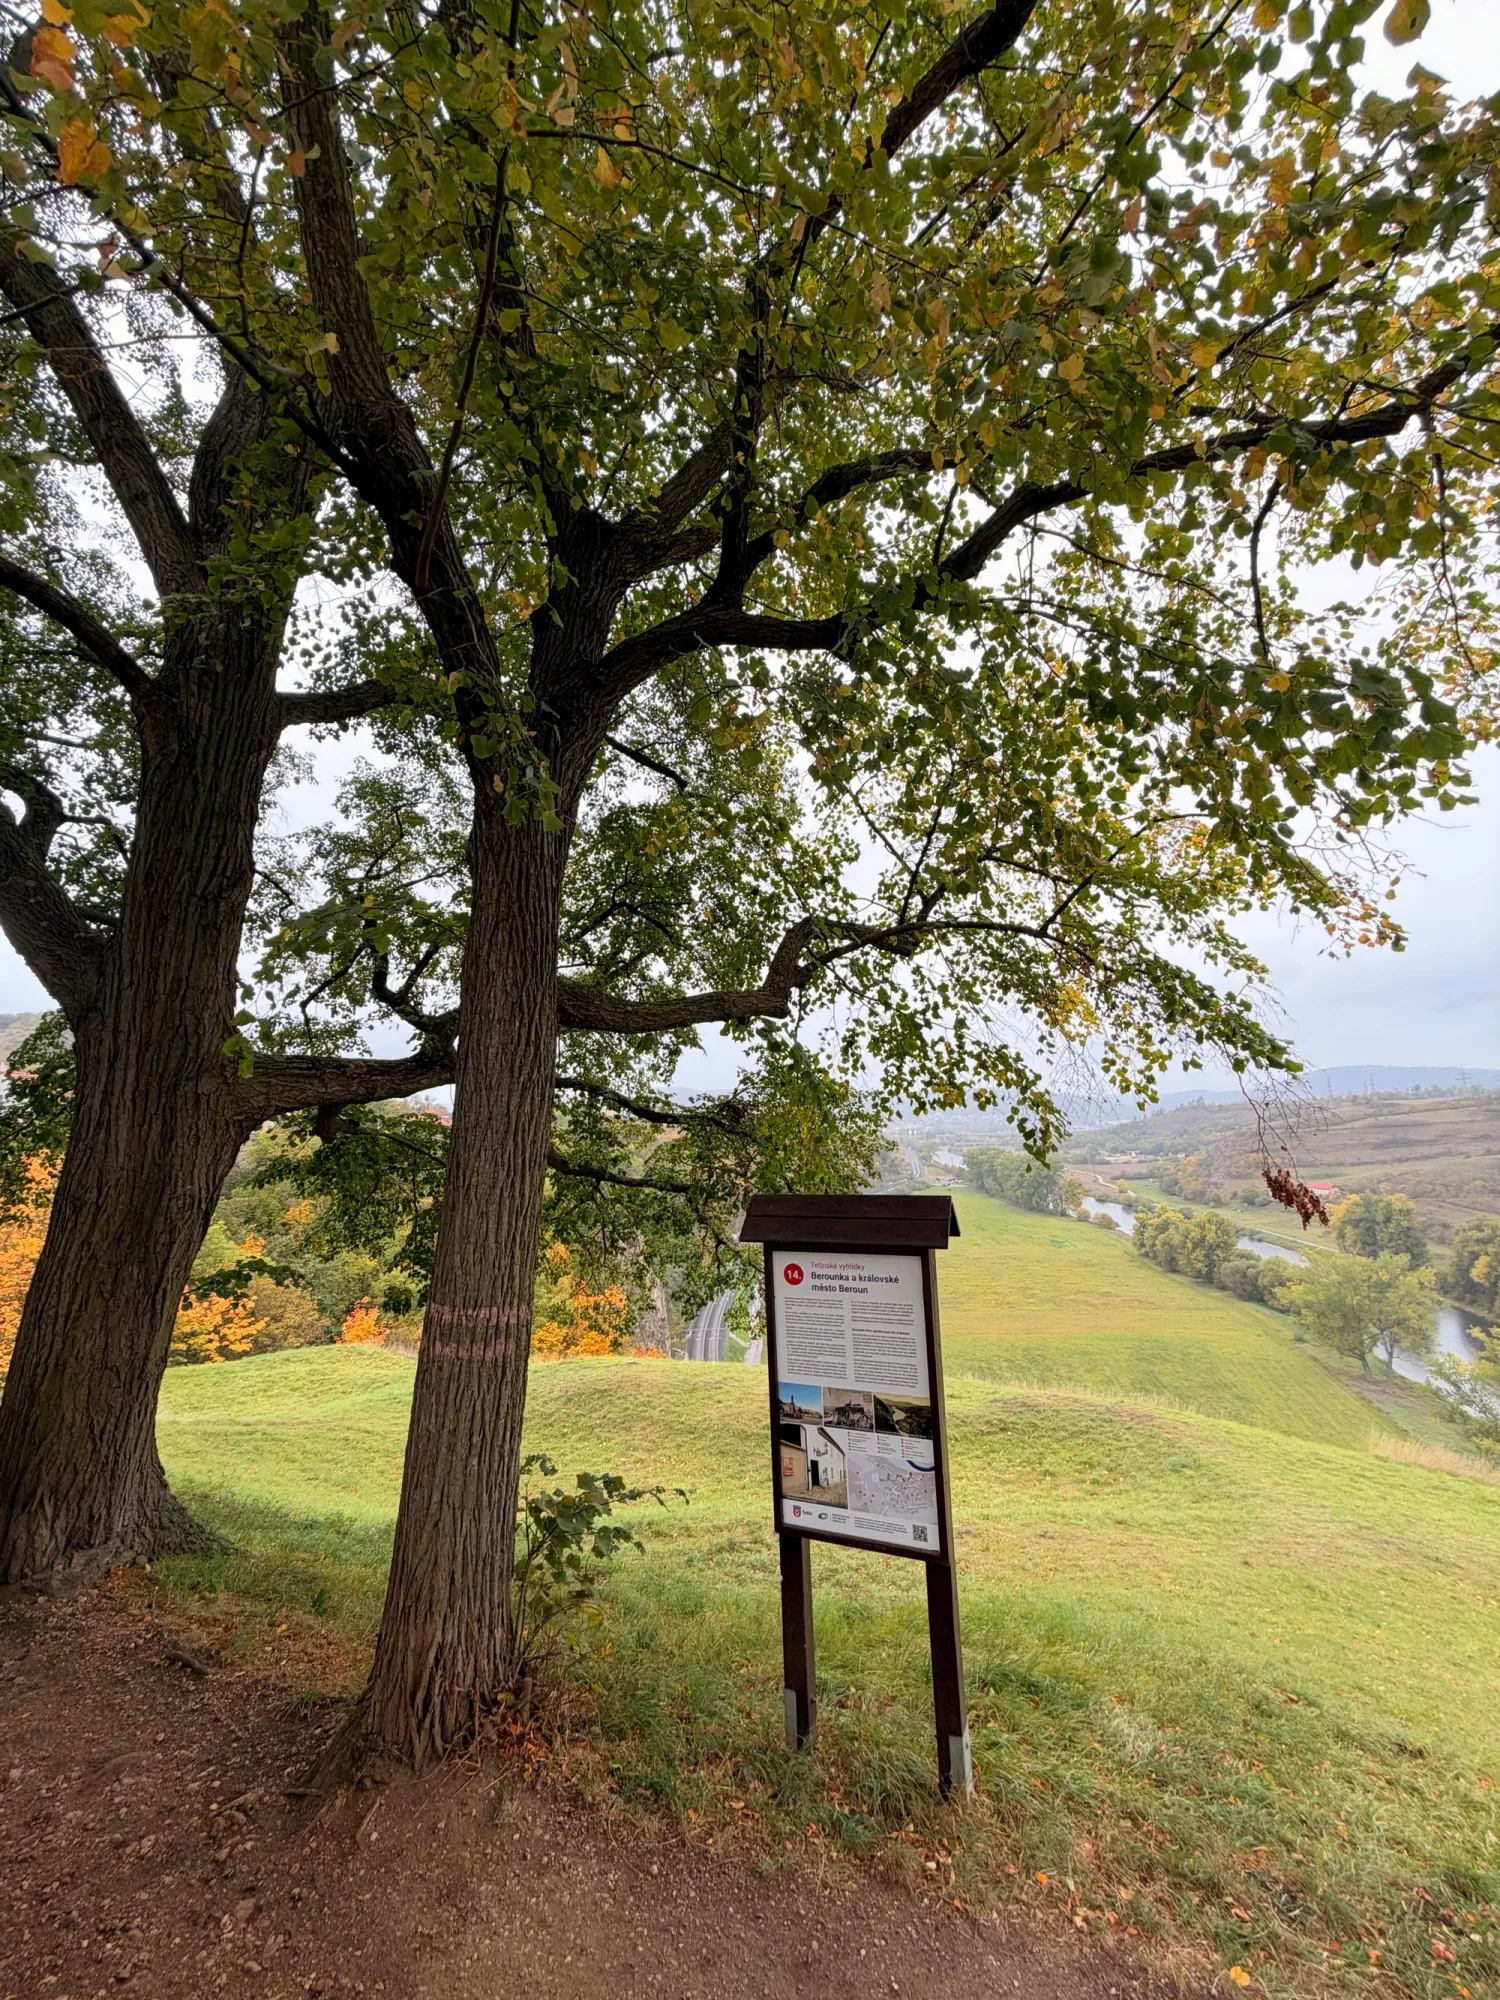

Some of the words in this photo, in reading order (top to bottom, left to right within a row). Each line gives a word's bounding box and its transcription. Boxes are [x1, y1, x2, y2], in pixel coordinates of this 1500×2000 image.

[839, 1262, 865, 1272] vyhlídky
[787, 1270, 802, 1280] 14.
[811, 1272, 849, 1281] Berounka
[858, 1273, 899, 1284] královské
[811, 1283, 837, 1292] město
[839, 1285, 868, 1294] Beroun
